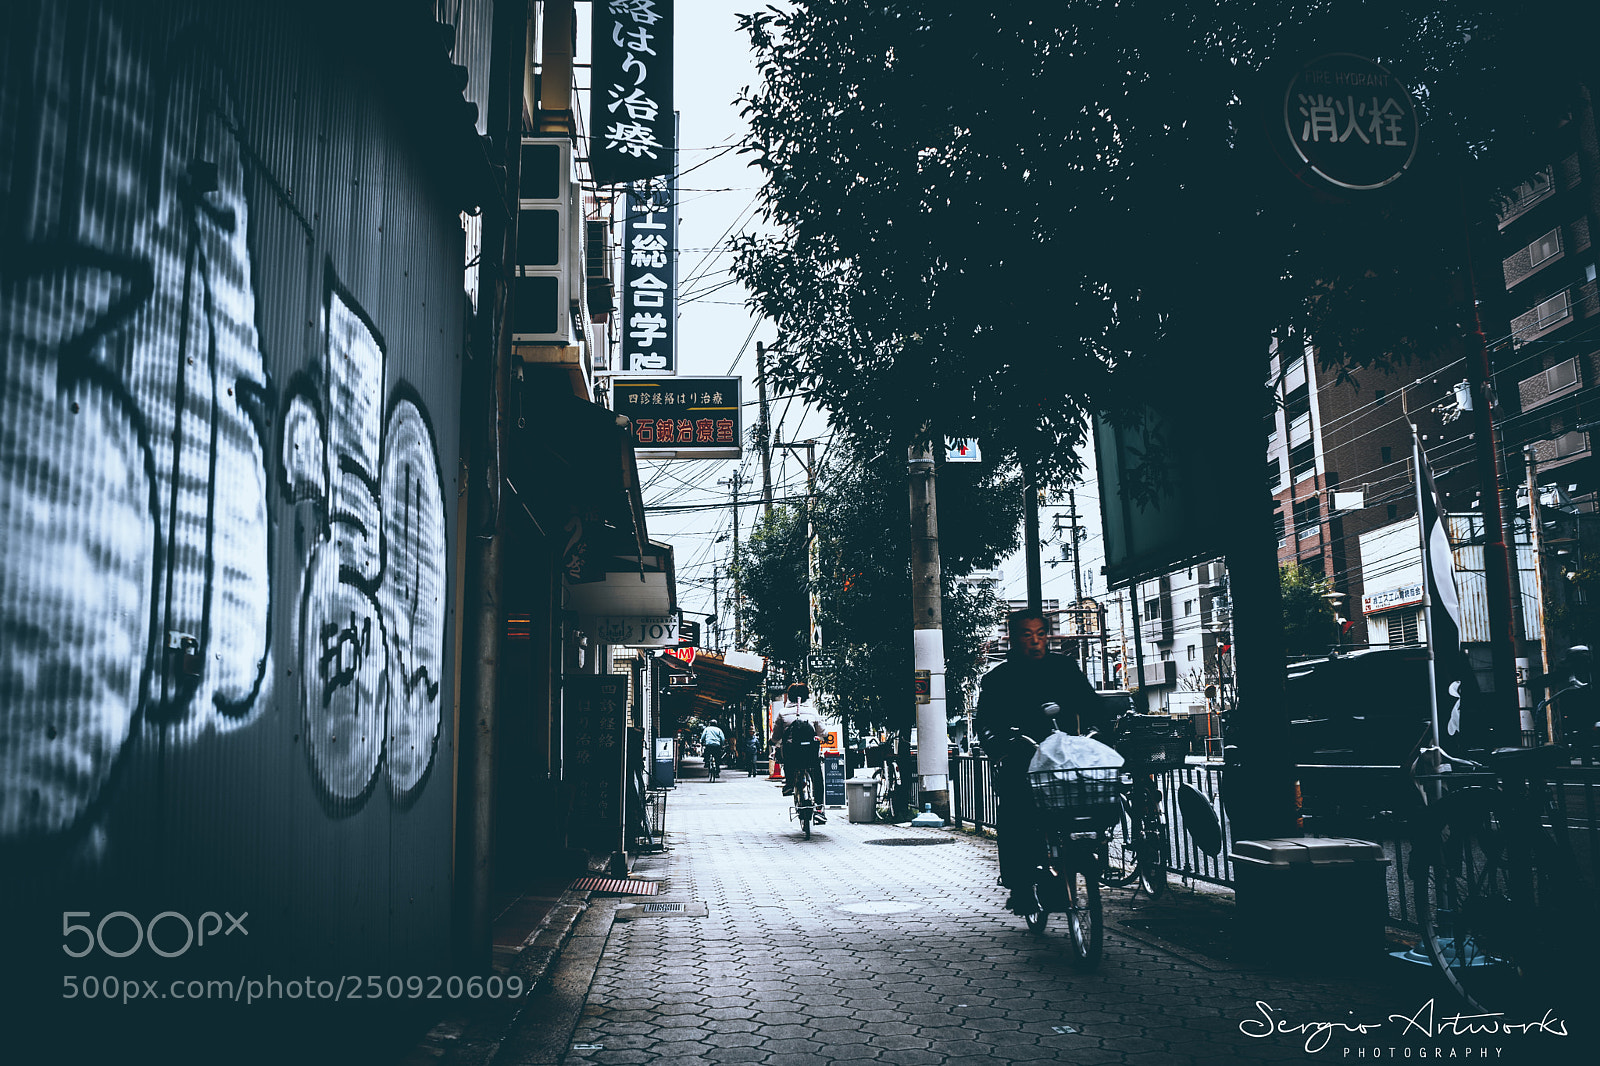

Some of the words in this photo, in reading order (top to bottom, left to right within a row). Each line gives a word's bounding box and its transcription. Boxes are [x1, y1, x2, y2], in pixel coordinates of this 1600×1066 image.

[1305, 70, 1332, 84] FIRE
[1335, 72, 1390, 88] HYDRANT
[1298, 93, 1408, 147] 消火栓
[628, 391, 724, 405] 四診経絡はり治療
[630, 418, 734, 443] 石鍼治療室
[638, 624, 678, 642] JOY
